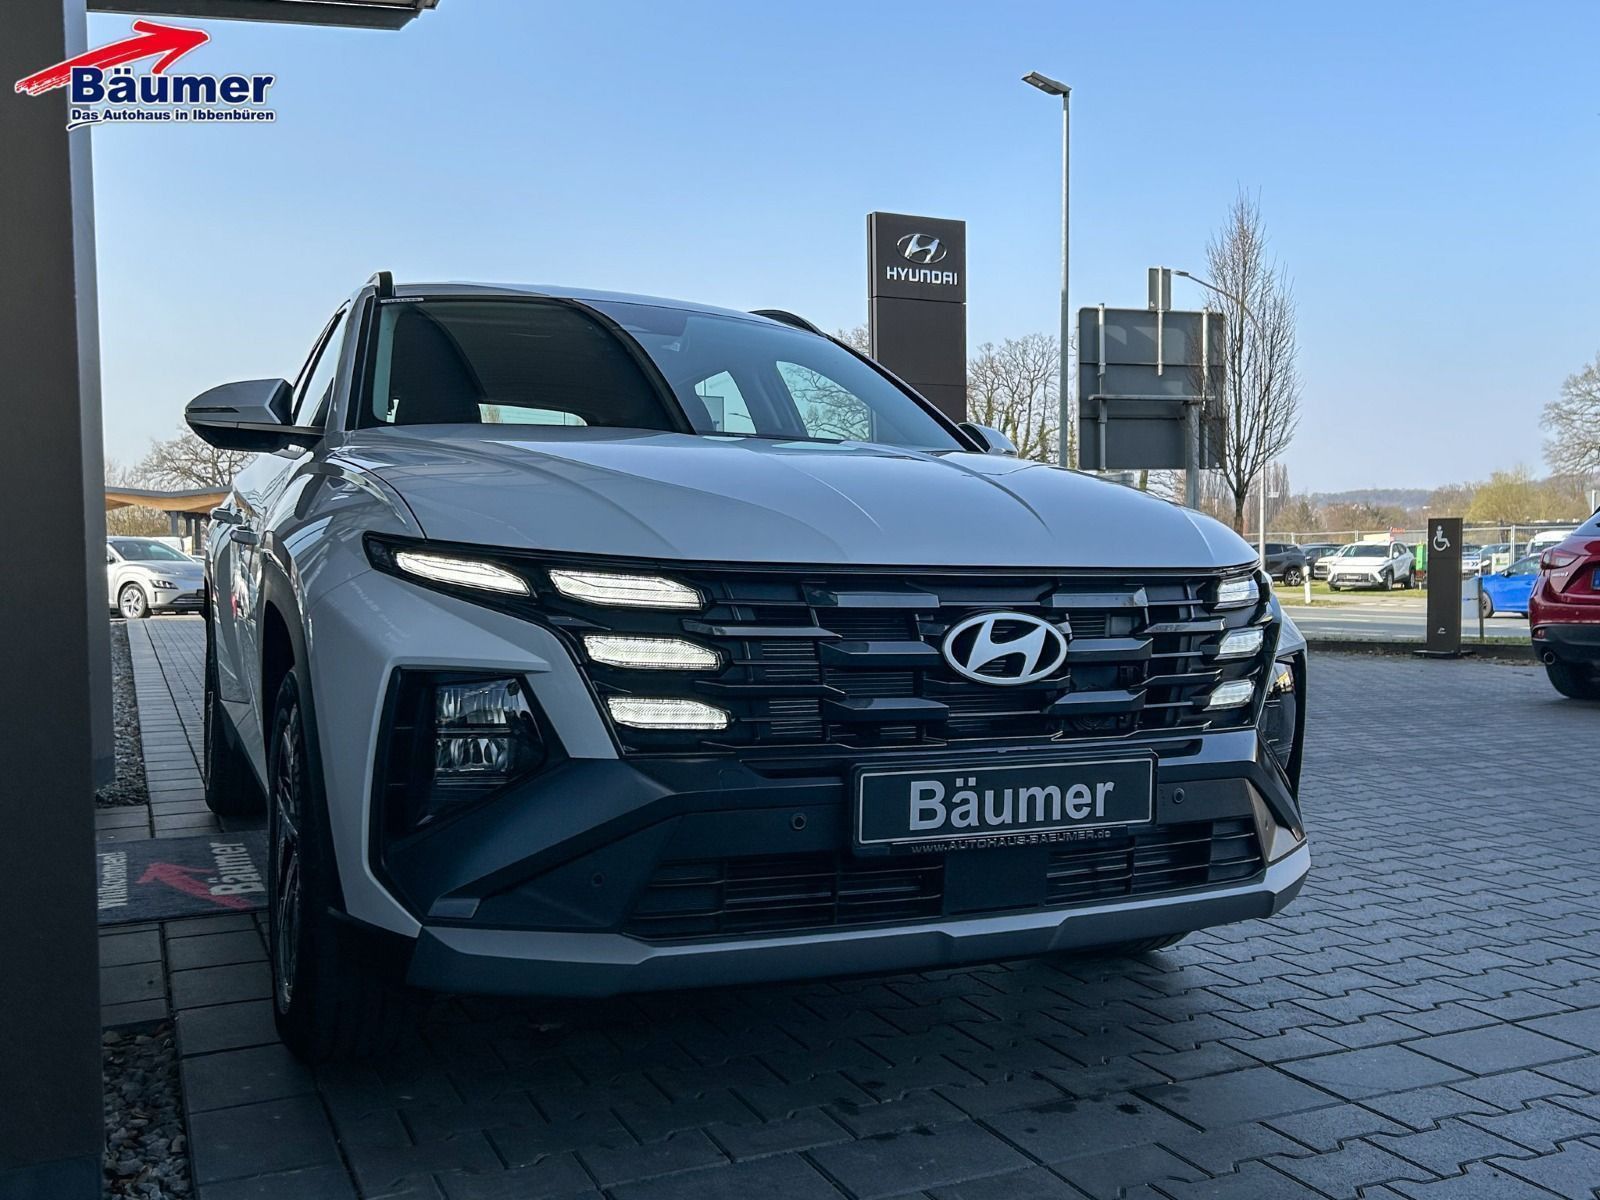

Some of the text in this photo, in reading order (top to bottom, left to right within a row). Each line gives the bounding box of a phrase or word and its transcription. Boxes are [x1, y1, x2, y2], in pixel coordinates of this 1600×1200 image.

[886, 266, 958, 286] HYUNDAI
[909, 777, 1115, 831] Bäumer
[209, 842, 266, 896] Bäumer
